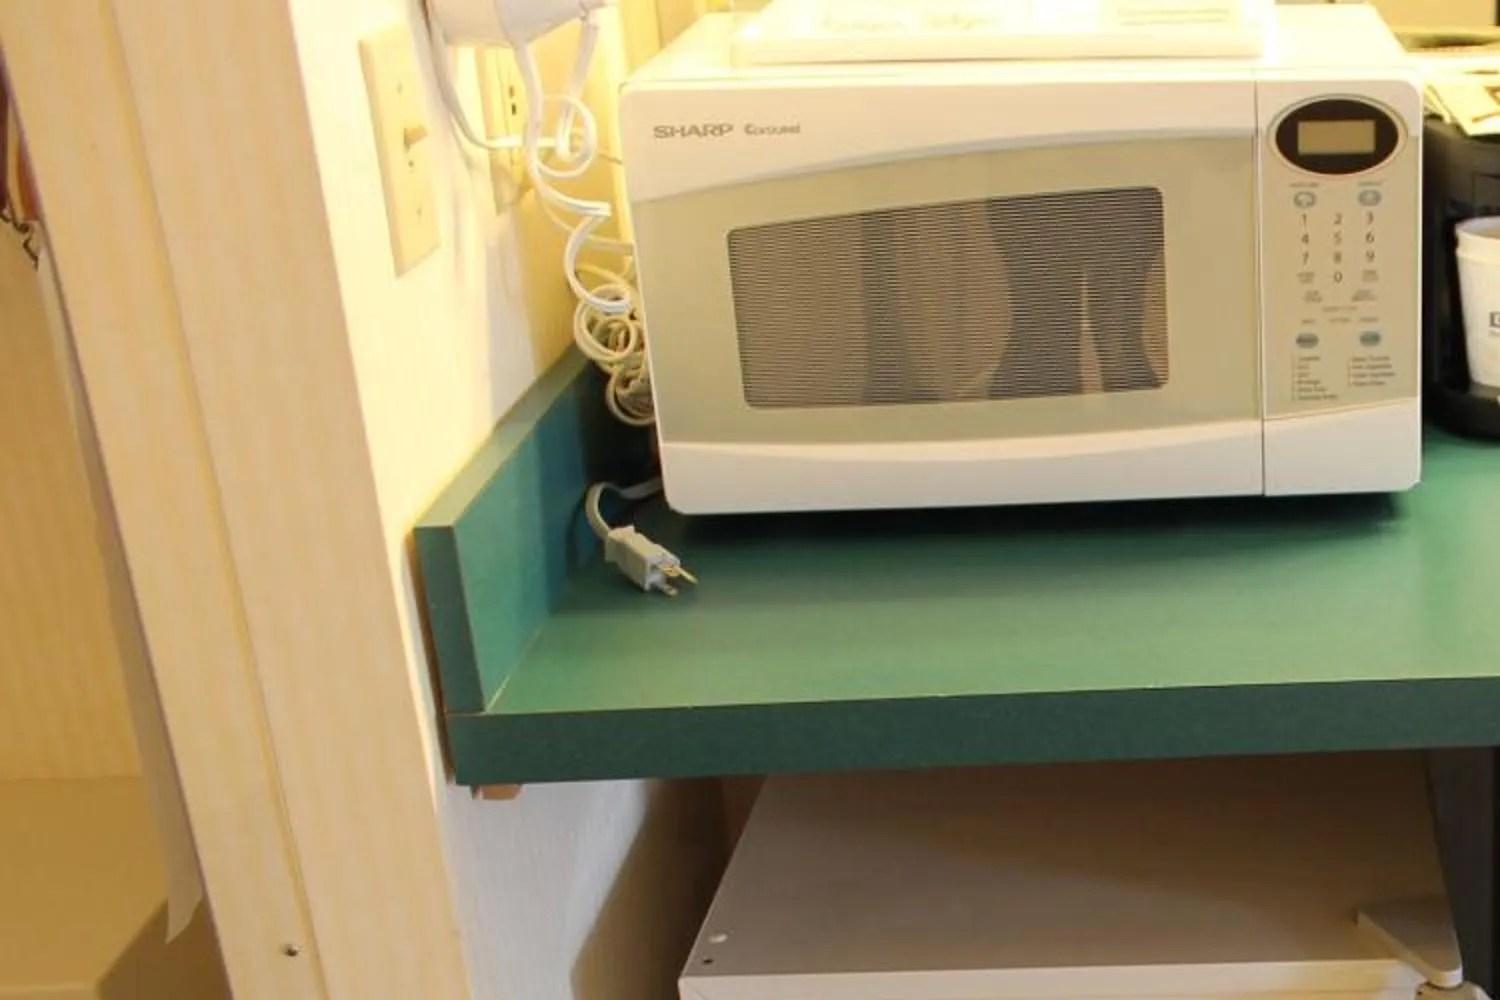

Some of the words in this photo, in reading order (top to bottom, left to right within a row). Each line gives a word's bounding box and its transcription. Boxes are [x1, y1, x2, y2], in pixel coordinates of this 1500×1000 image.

[653, 123, 734, 139] SHARP
[1333, 212, 1343, 226] 2
[1366, 210, 1375, 226] 3
[1300, 233, 1310, 245] 4
[1333, 231, 1343, 246] 5
[1365, 230, 1375, 244] 6
[1301, 251, 1310, 266] 7
[1333, 251, 1342, 266] 8
[1365, 250, 1375, 263] 9
[1333, 270, 1343, 284] 0
